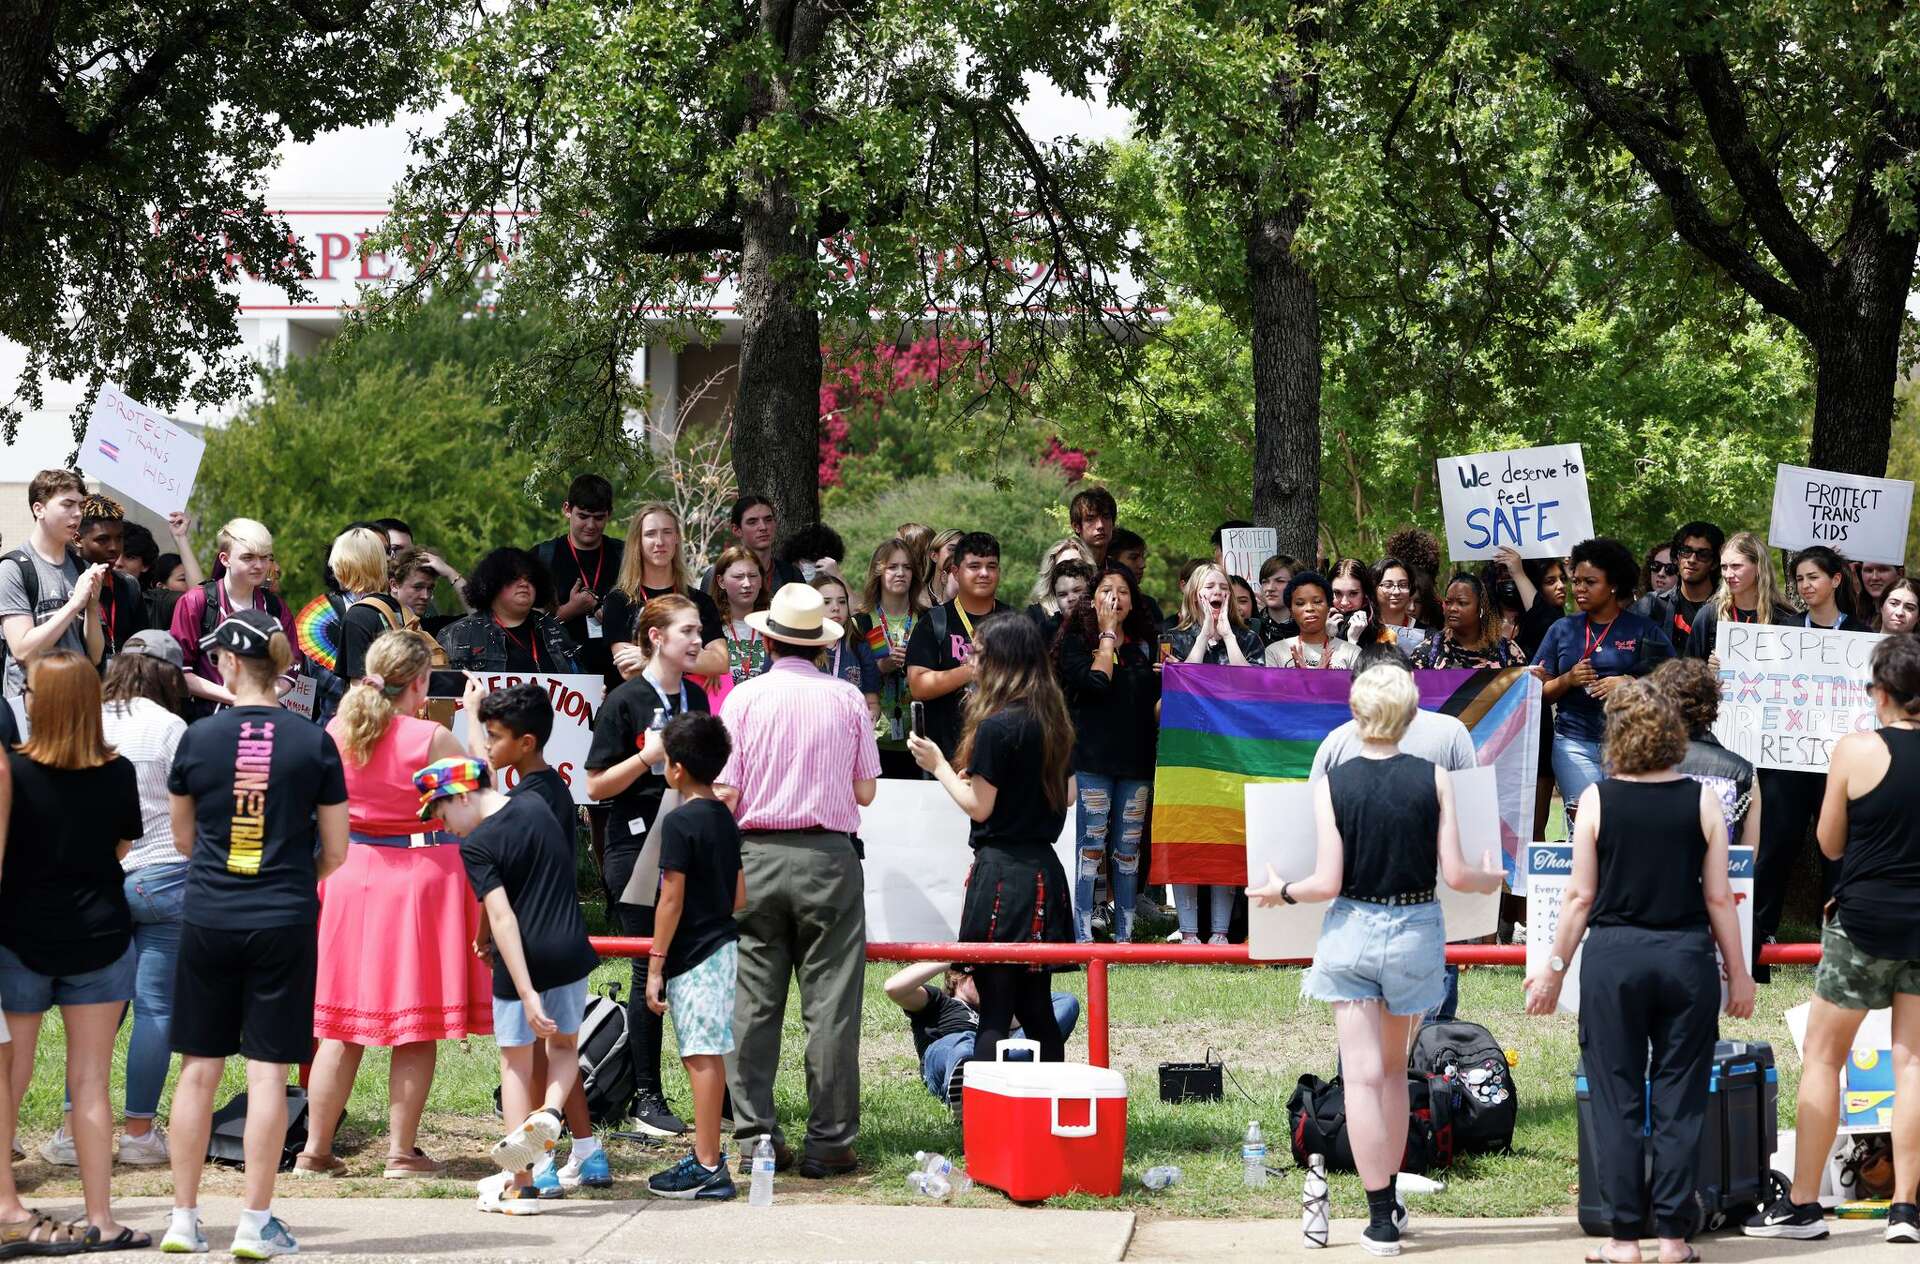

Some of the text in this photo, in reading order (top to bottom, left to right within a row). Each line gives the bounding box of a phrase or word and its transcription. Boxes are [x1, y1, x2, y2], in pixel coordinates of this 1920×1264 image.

[166, 231, 522, 281] RAPEVN
[125, 427, 169, 463] TRANS
[1457, 455, 1580, 489] We deserve to
[1497, 485, 1531, 506] feel
[1805, 481, 1883, 510] PROTECT
[1463, 500, 1560, 549] SAFE
[1808, 504, 1861, 523] TRANS
[1228, 530, 1273, 549] PROTECT
[1812, 521, 1849, 541] KIDS
[1728, 626, 1878, 669] RESPEC
[454, 676, 601, 732] ERTION
[1718, 669, 1874, 708] EXISTAN
[233, 739, 273, 791] RUN
[1760, 734, 1834, 766] RESIS
[232, 789, 266, 817] TO
[226, 814, 266, 870] TRAIN
[1533, 848, 1574, 871] Than
[1534, 884, 1562, 895] Every
